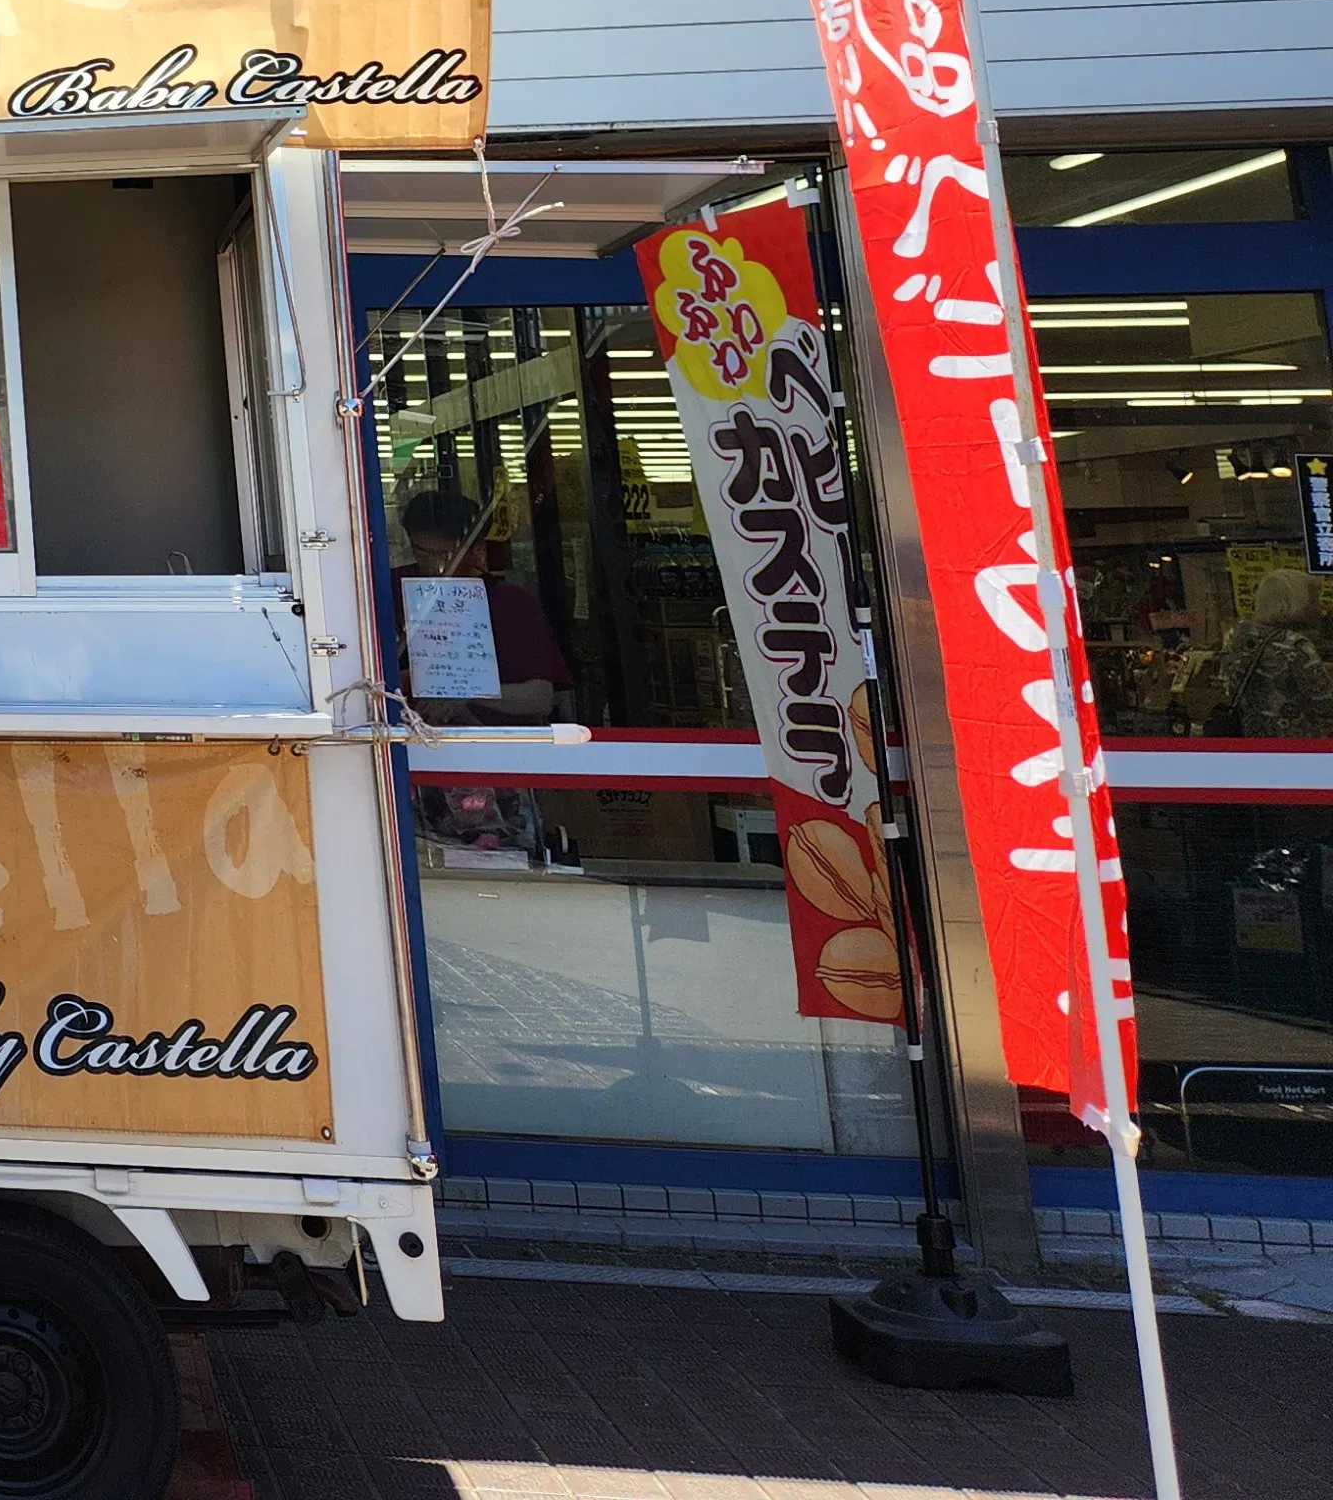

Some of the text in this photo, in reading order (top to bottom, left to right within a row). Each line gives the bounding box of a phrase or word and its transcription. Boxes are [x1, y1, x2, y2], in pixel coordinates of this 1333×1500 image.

[8, 43, 482, 116] Baby Castella
[708, 403, 853, 807] カステラ
[34, 993, 318, 1081] Castella
